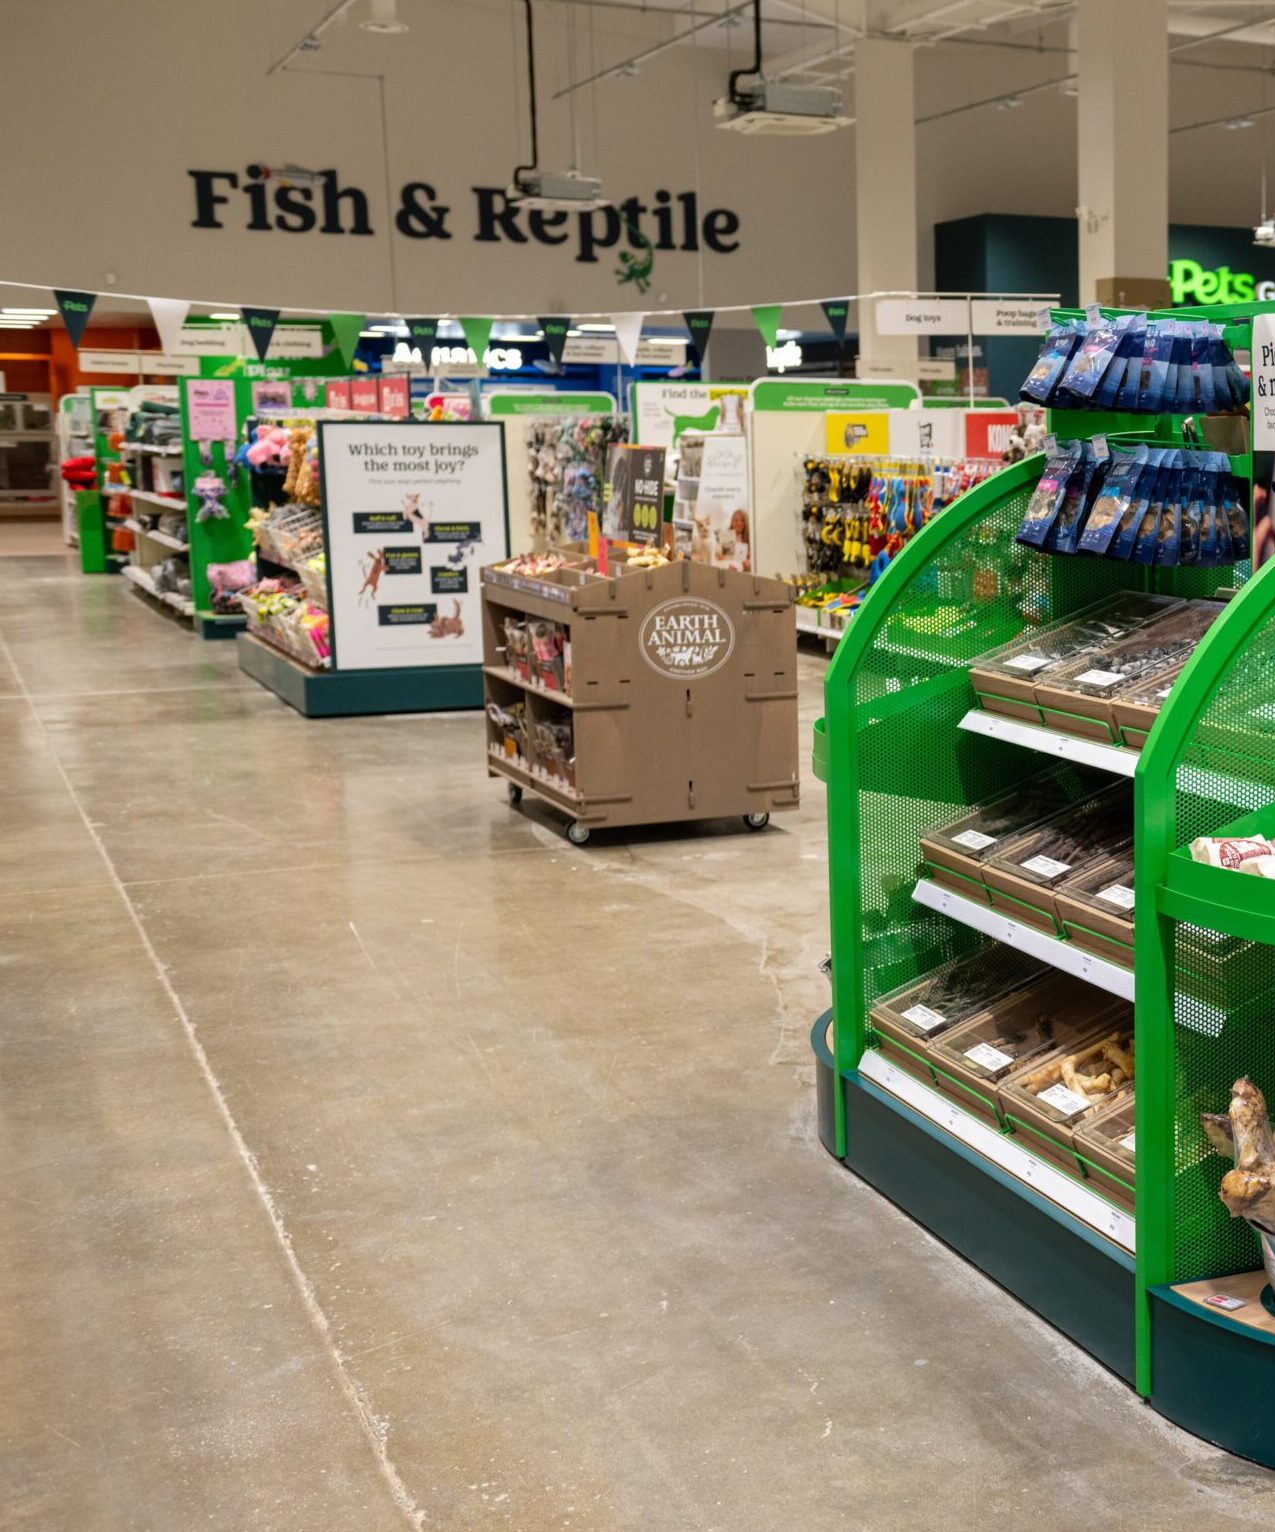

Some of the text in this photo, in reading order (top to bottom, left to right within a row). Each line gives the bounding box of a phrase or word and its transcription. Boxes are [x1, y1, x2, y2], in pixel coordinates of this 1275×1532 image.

[187, 164, 741, 262] Fish & Reptile
[1167, 259, 1256, 305] Pets
[905, 312, 942, 324] Dog toys
[662, 388, 688, 399] Find
[689, 388, 708, 399] the
[1257, 374, 1267, 397] &
[348, 443, 479, 459] Which toy brings
[364, 459, 465, 474] the most joy?
[655, 614, 718, 631] EARTH
[647, 628, 727, 646] ANIMAL
